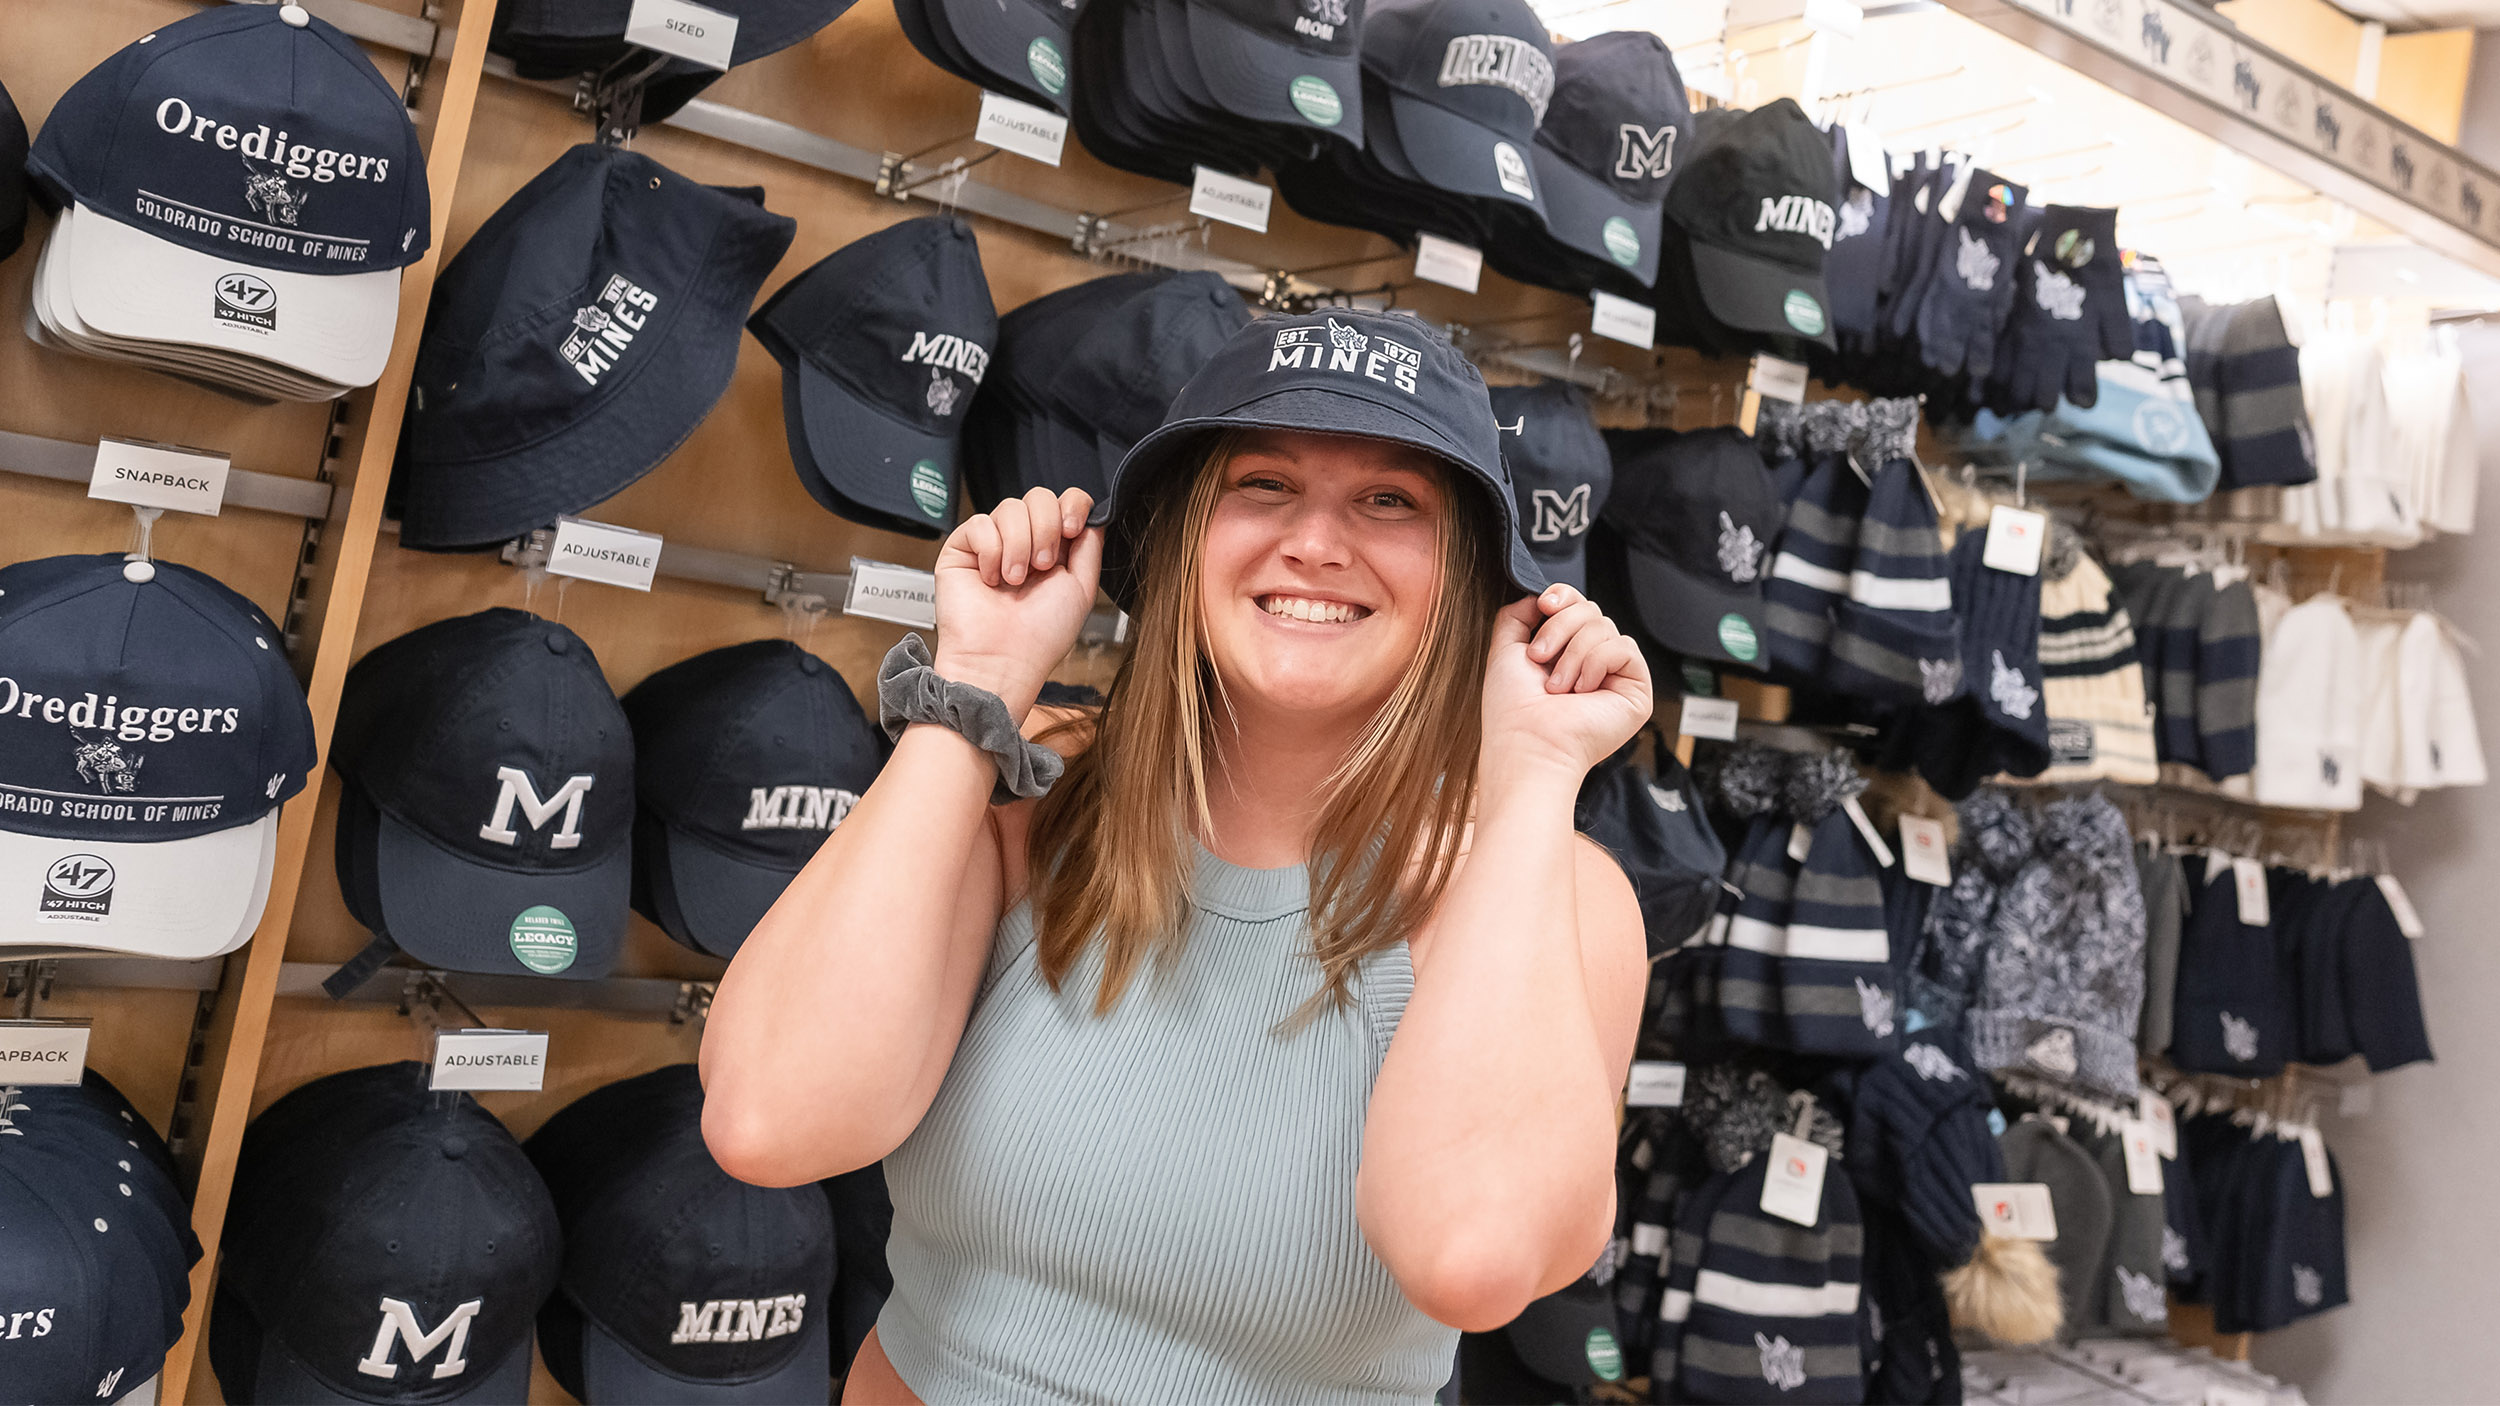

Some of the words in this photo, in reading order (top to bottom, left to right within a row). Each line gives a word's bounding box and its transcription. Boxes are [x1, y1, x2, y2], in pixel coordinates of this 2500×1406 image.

[665, 18, 705, 38] SIZED
[1294, 16, 1334, 41] MOM
[155, 97, 390, 183] Orediggers
[988, 112, 1059, 142] ADJUSTABLE
[1615, 123, 1677, 179] M
[136, 197, 222, 236] COLORADO
[227, 225, 296, 253] SCHOOL
[302, 241, 322, 256] OF
[327, 245, 367, 261] MINES
[221, 322, 269, 336] ADJUSTABLE
[237, 312, 272, 327] HITCH
[575, 285, 658, 386] MINES
[901, 331, 989, 384] MINES
[1278, 330, 1309, 346] EST.
[1383, 342, 1418, 367] 1874
[1267, 346, 1418, 395] MINES
[115, 467, 210, 492] SNAPBACK
[1531, 483, 1591, 541] M
[562, 542, 652, 569] ADJUSTABLE
[61, 800, 136, 822] SCHOOL
[144, 804, 168, 822] OF
[172, 803, 221, 822] MINES
[480, 766, 594, 849] M
[742, 785, 861, 831] MINE
[47, 914, 100, 922] ADJUSTABLE
[65, 900, 106, 911] HITCH
[514, 932, 575, 946] LEGACY
[445, 1055, 540, 1066] ADJUSTABLE
[0, 1308, 55, 1340] rs
[671, 1293, 806, 1343] MINES
[358, 1297, 481, 1379] M
